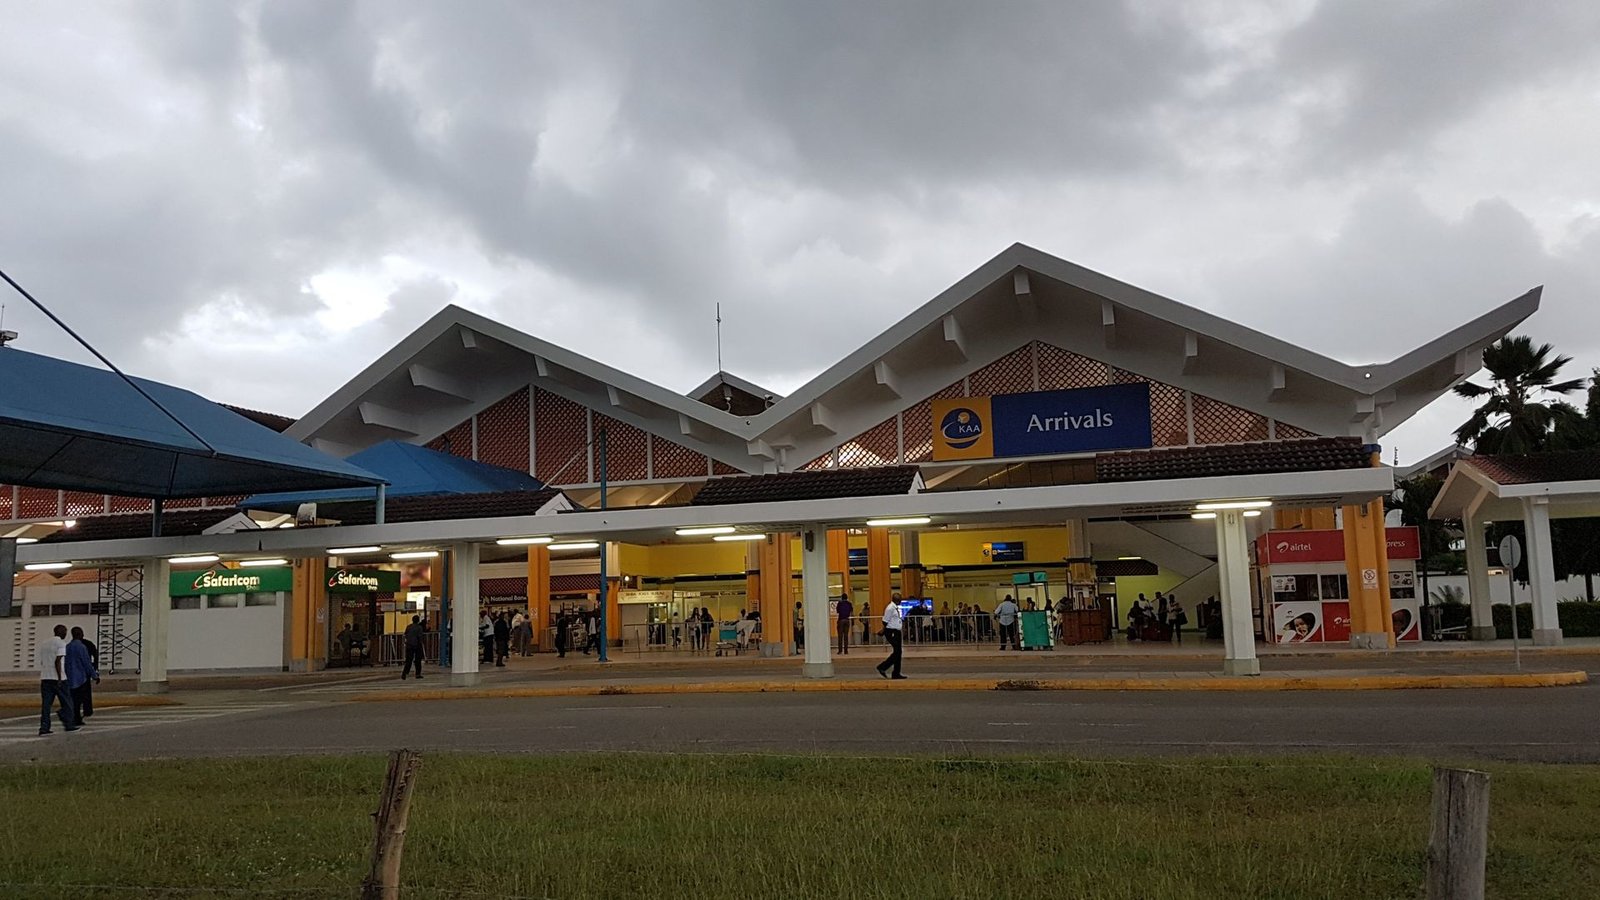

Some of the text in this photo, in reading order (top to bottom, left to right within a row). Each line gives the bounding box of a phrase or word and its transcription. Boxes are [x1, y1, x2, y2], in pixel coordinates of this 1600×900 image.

[1026, 408, 1114, 433] Arrivals
[958, 424, 981, 433] KAA
[1290, 543, 1312, 552] airtel
[1386, 540, 1405, 549] press
[203, 574, 260, 587] Safaricom
[337, 573, 378, 586] Safaricom
